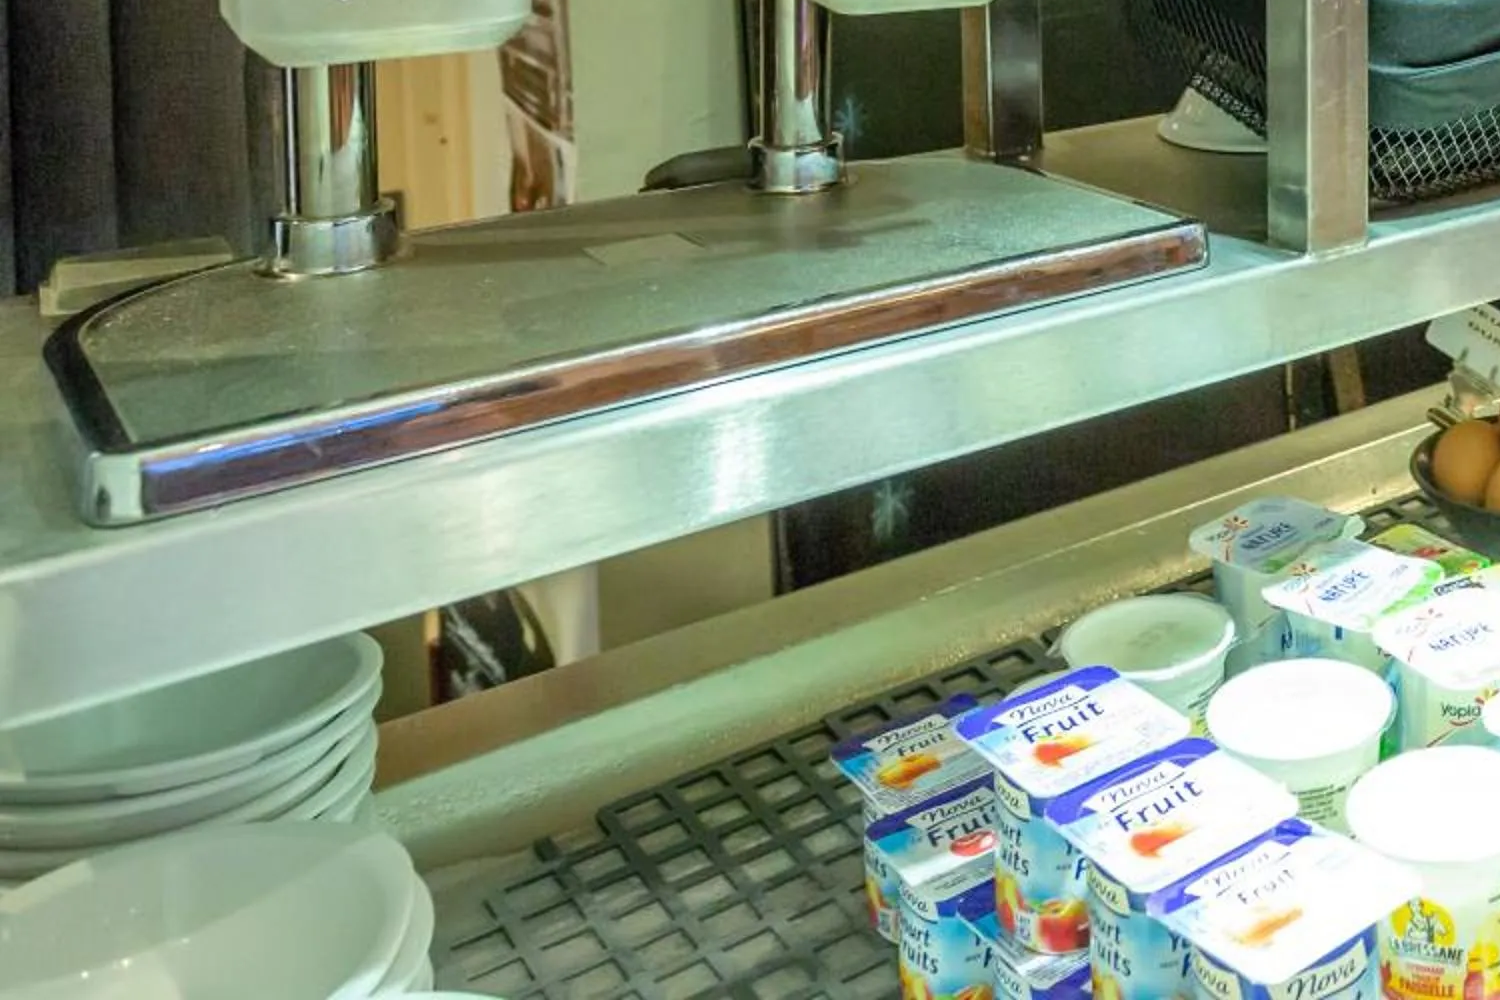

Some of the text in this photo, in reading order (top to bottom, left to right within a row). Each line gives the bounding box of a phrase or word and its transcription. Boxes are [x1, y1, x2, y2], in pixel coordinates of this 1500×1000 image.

[1021, 701, 1105, 744] Fruit
[1441, 701, 1482, 719] Yopla
[896, 733, 944, 757] Fruit
[1115, 780, 1203, 833] Fruit
